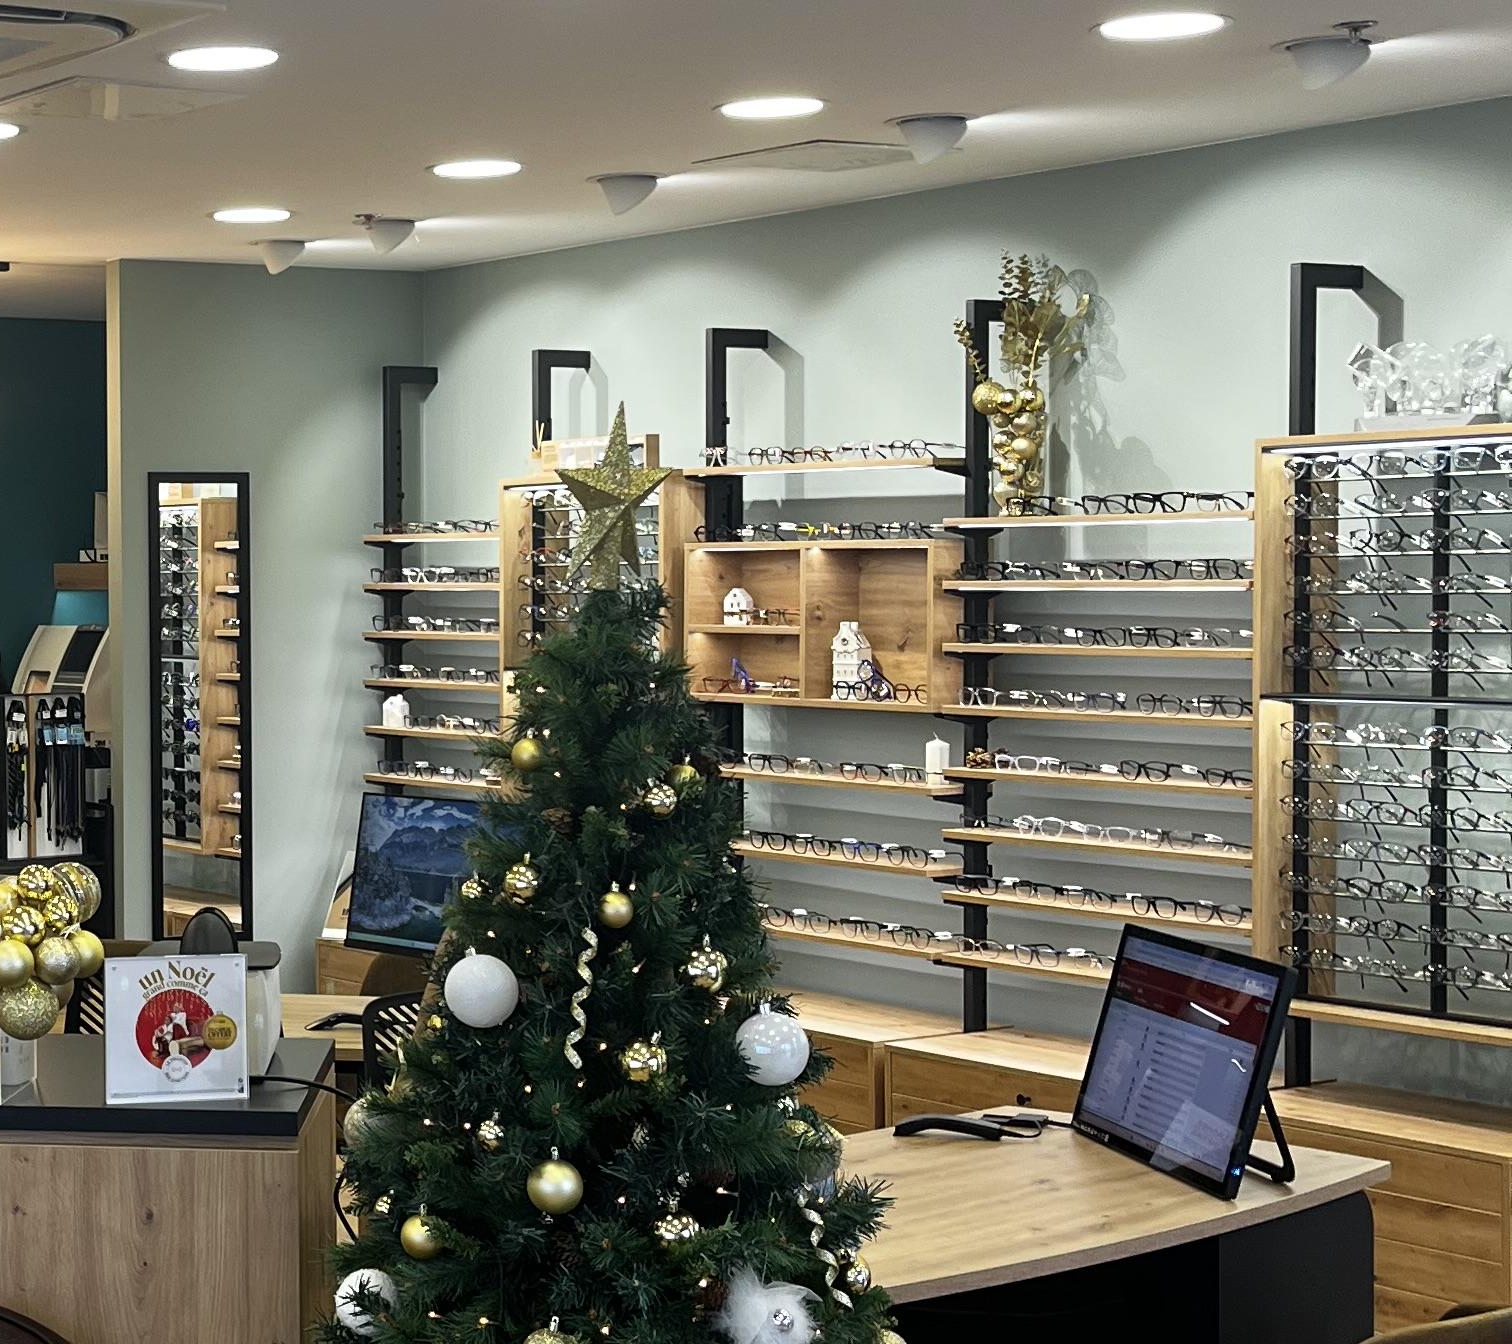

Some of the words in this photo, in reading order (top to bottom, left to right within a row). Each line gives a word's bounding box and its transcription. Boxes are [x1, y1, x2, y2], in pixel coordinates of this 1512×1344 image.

[138, 968, 164, 990] un
[168, 960, 216, 988] Noël
[142, 981, 166, 1000] grand
[166, 980, 199, 990] comme
